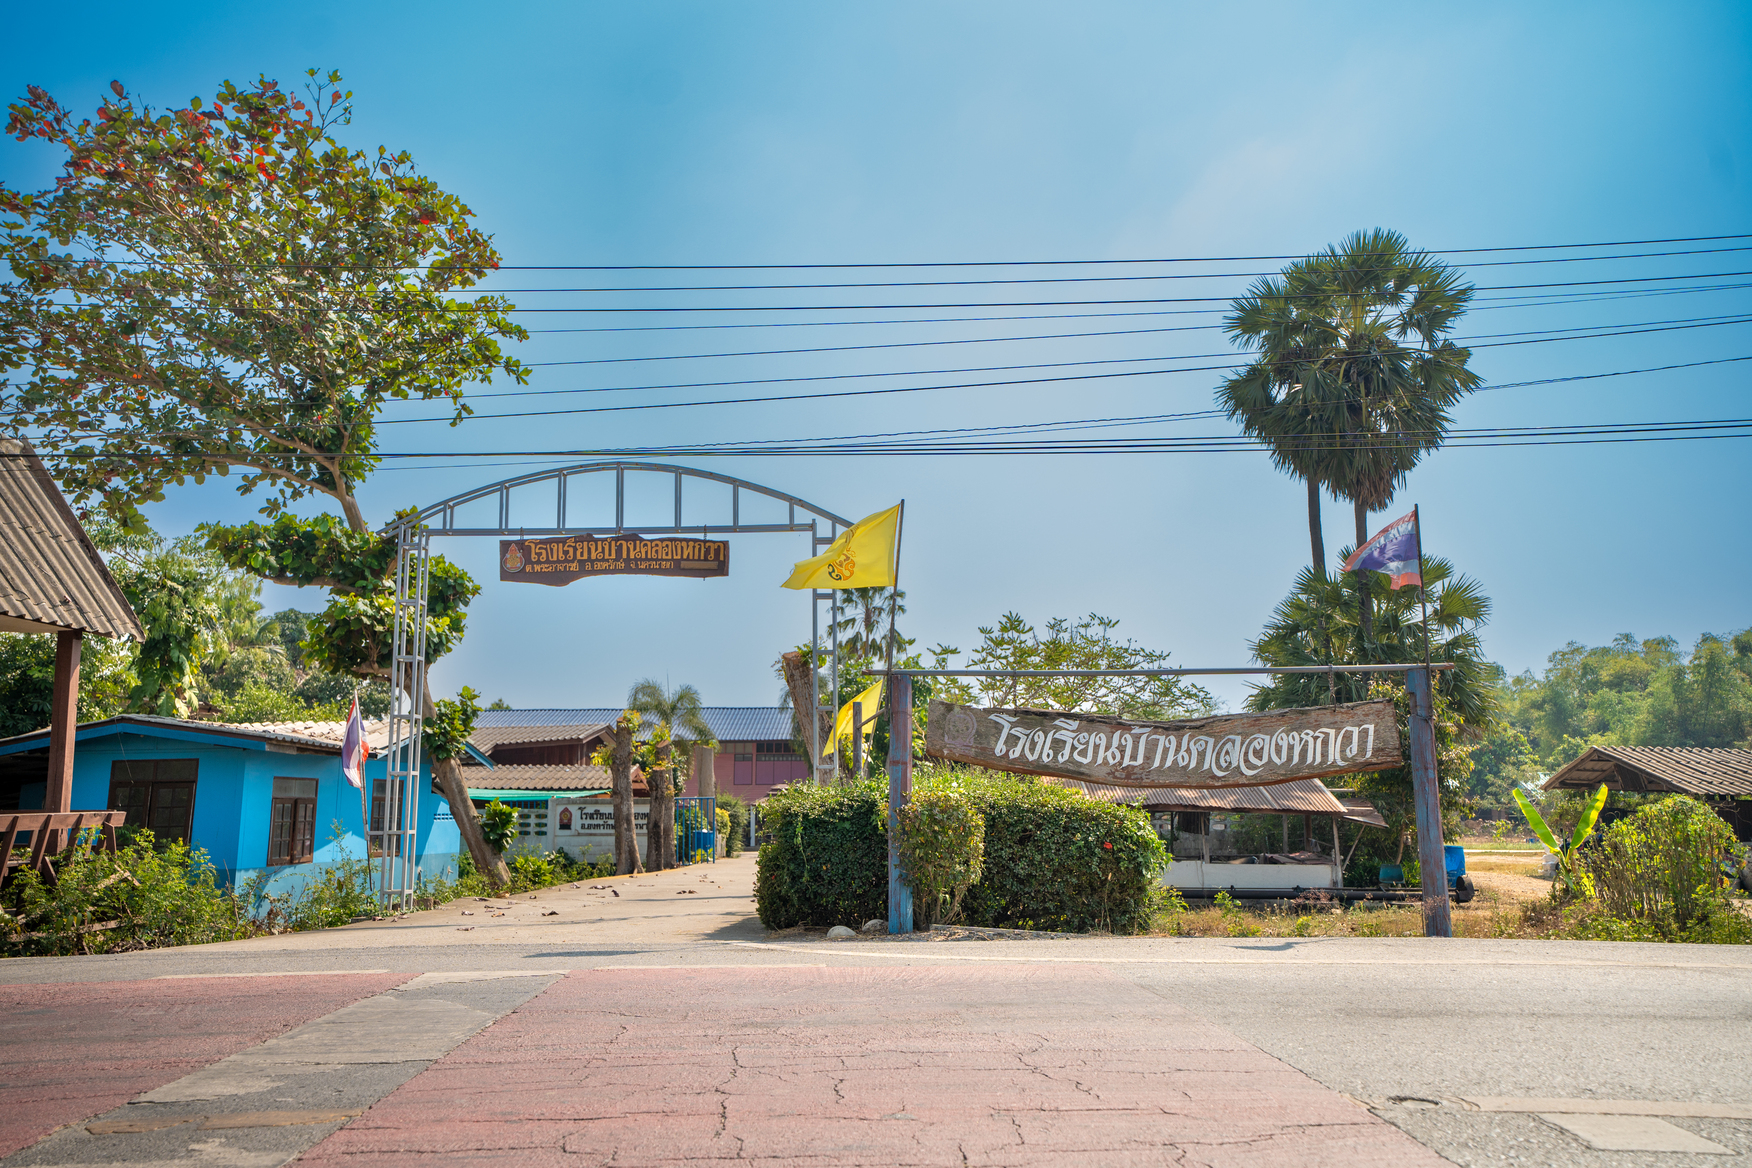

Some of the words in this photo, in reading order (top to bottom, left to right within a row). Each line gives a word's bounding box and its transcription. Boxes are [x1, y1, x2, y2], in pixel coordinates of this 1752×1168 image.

[524, 537, 724, 562] โรงเรียนบ้านคลองหกวา
[987, 713, 1375, 777] โรงเรียนบ้านคลองหกวา
